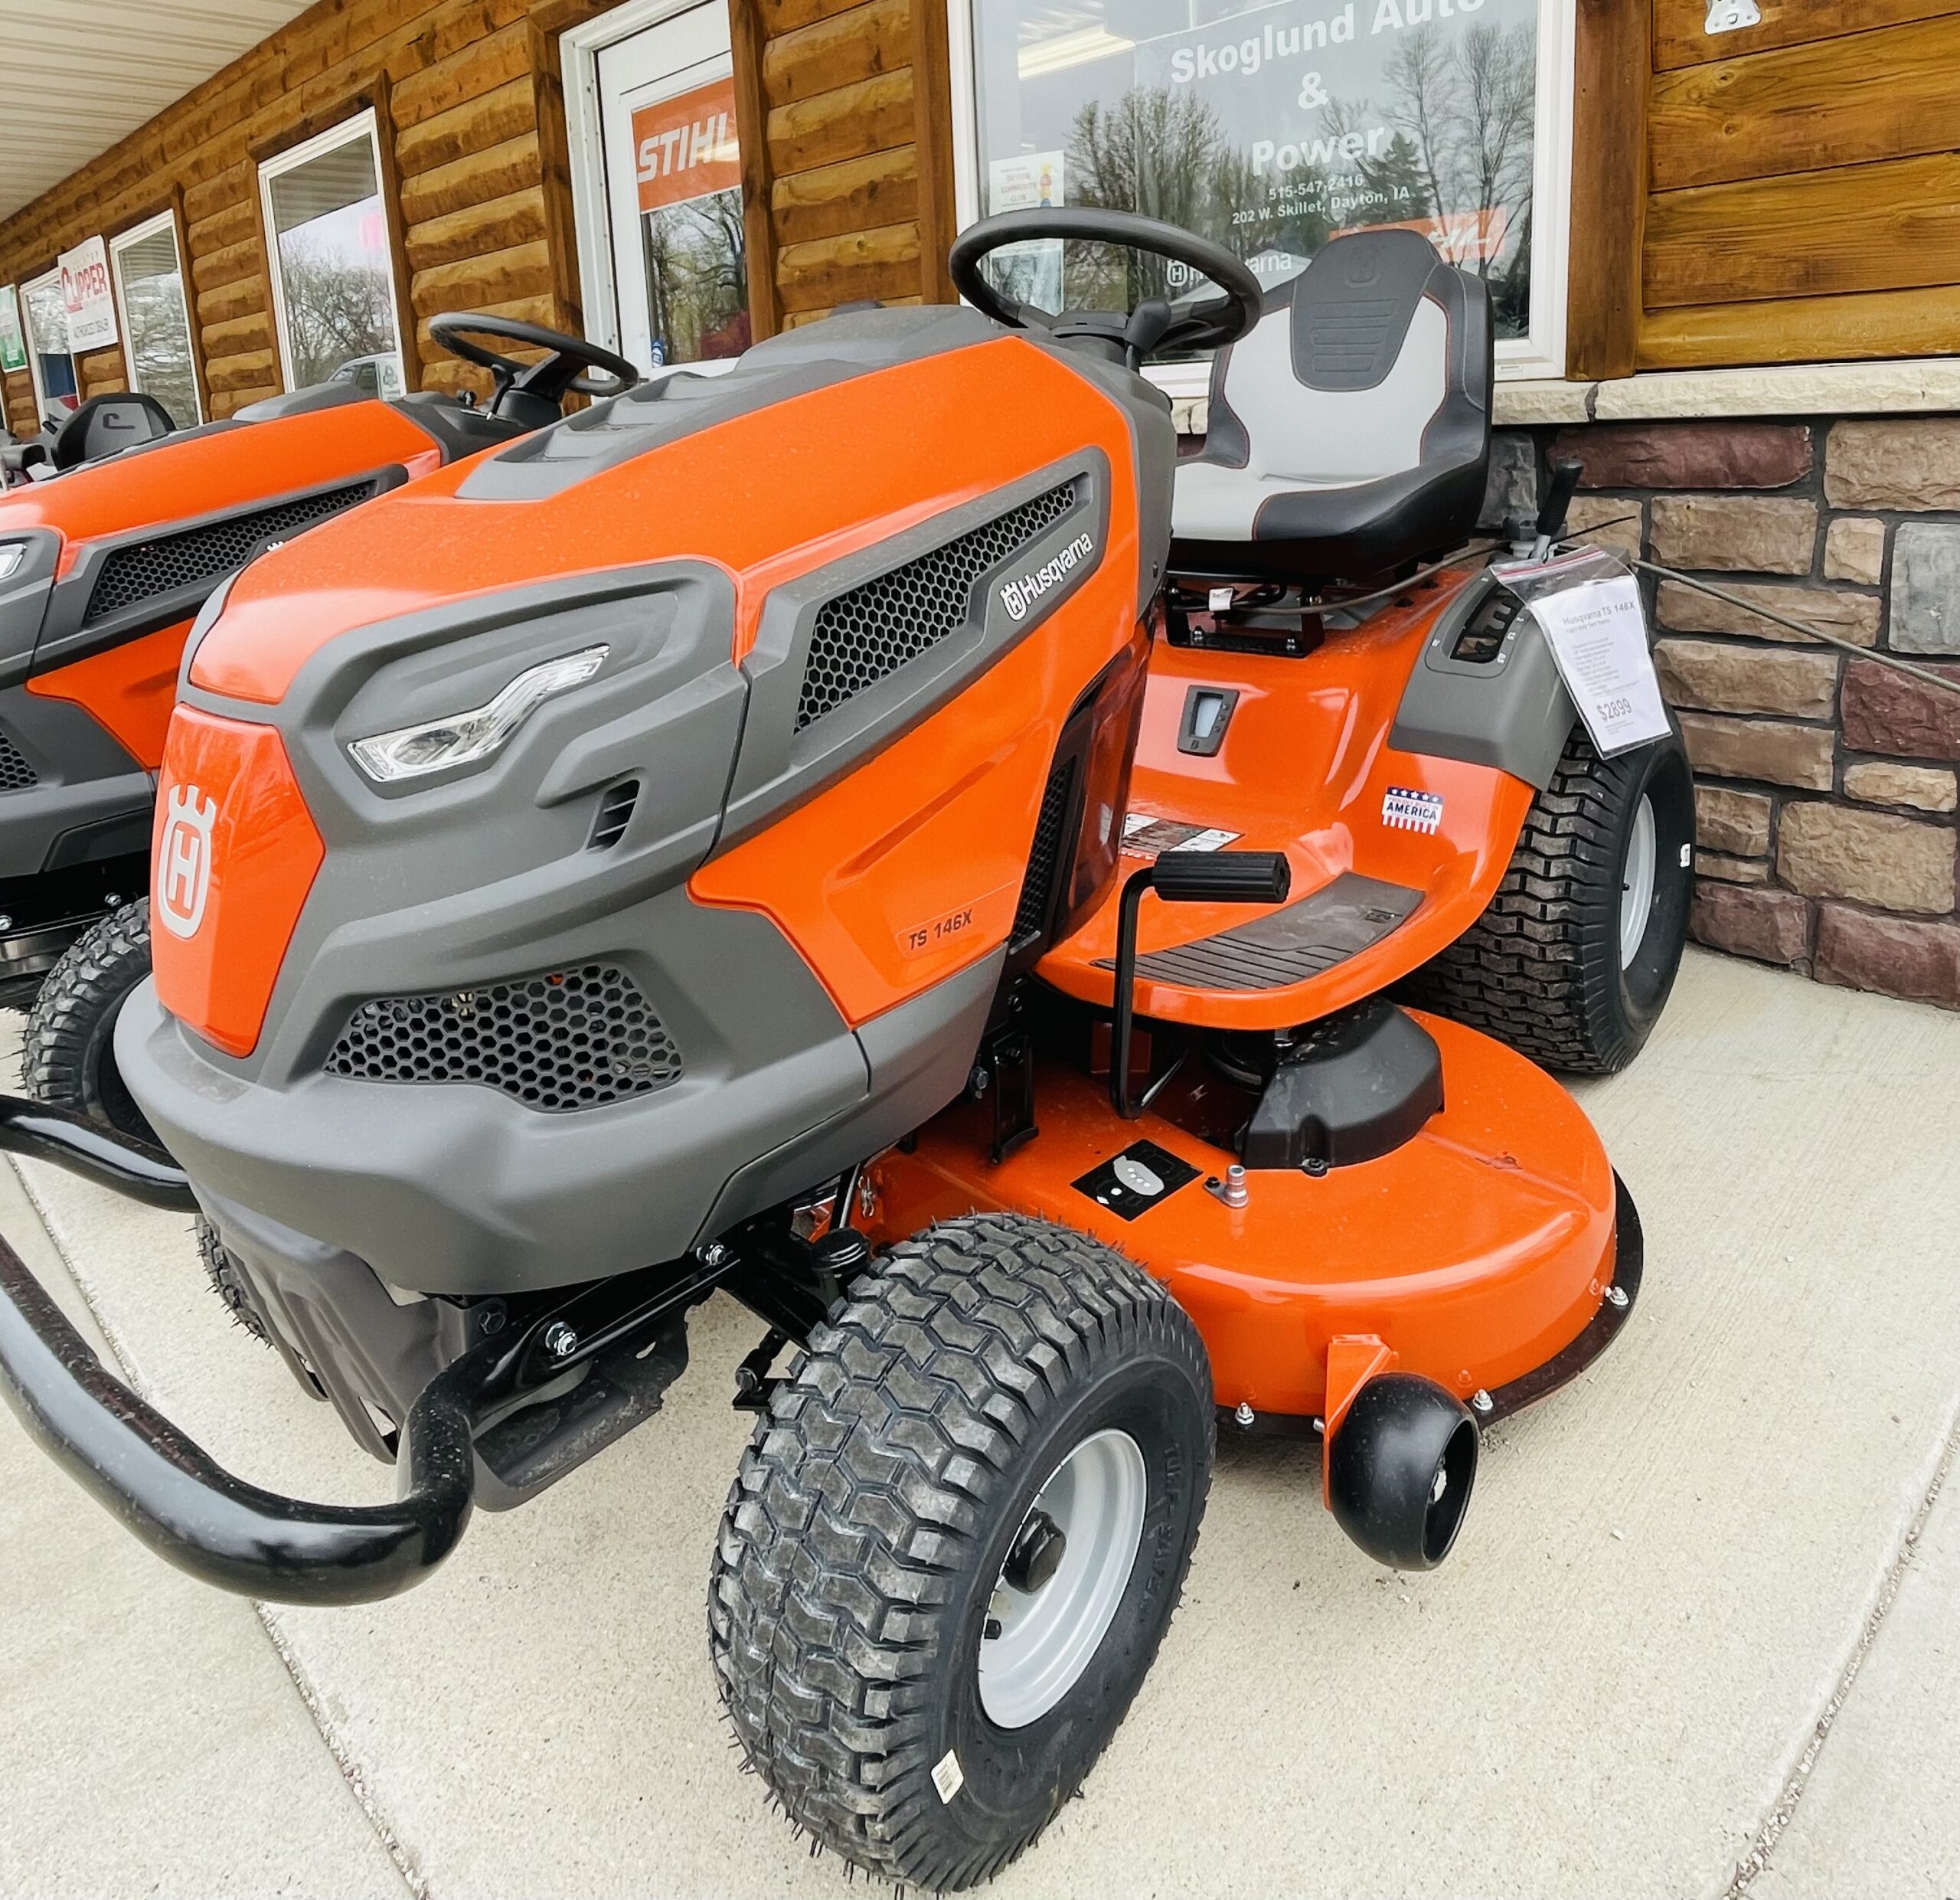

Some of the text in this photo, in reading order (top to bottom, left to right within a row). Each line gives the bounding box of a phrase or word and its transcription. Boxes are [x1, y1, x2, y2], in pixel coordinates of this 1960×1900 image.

[1171, 3, 1354, 83] Skoglund
[1298, 71, 1329, 110] &
[638, 111, 740, 184] STIHL
[1252, 126, 1385, 178] Power
[1232, 185, 1410, 225] 202 W. Skillet, Dayton, IA
[1017, 532, 1093, 605] Husqvarna
[1596, 698, 1632, 722] $2899
[1387, 802, 1437, 820] AMERICA
[908, 908, 973, 950] TS 146X
